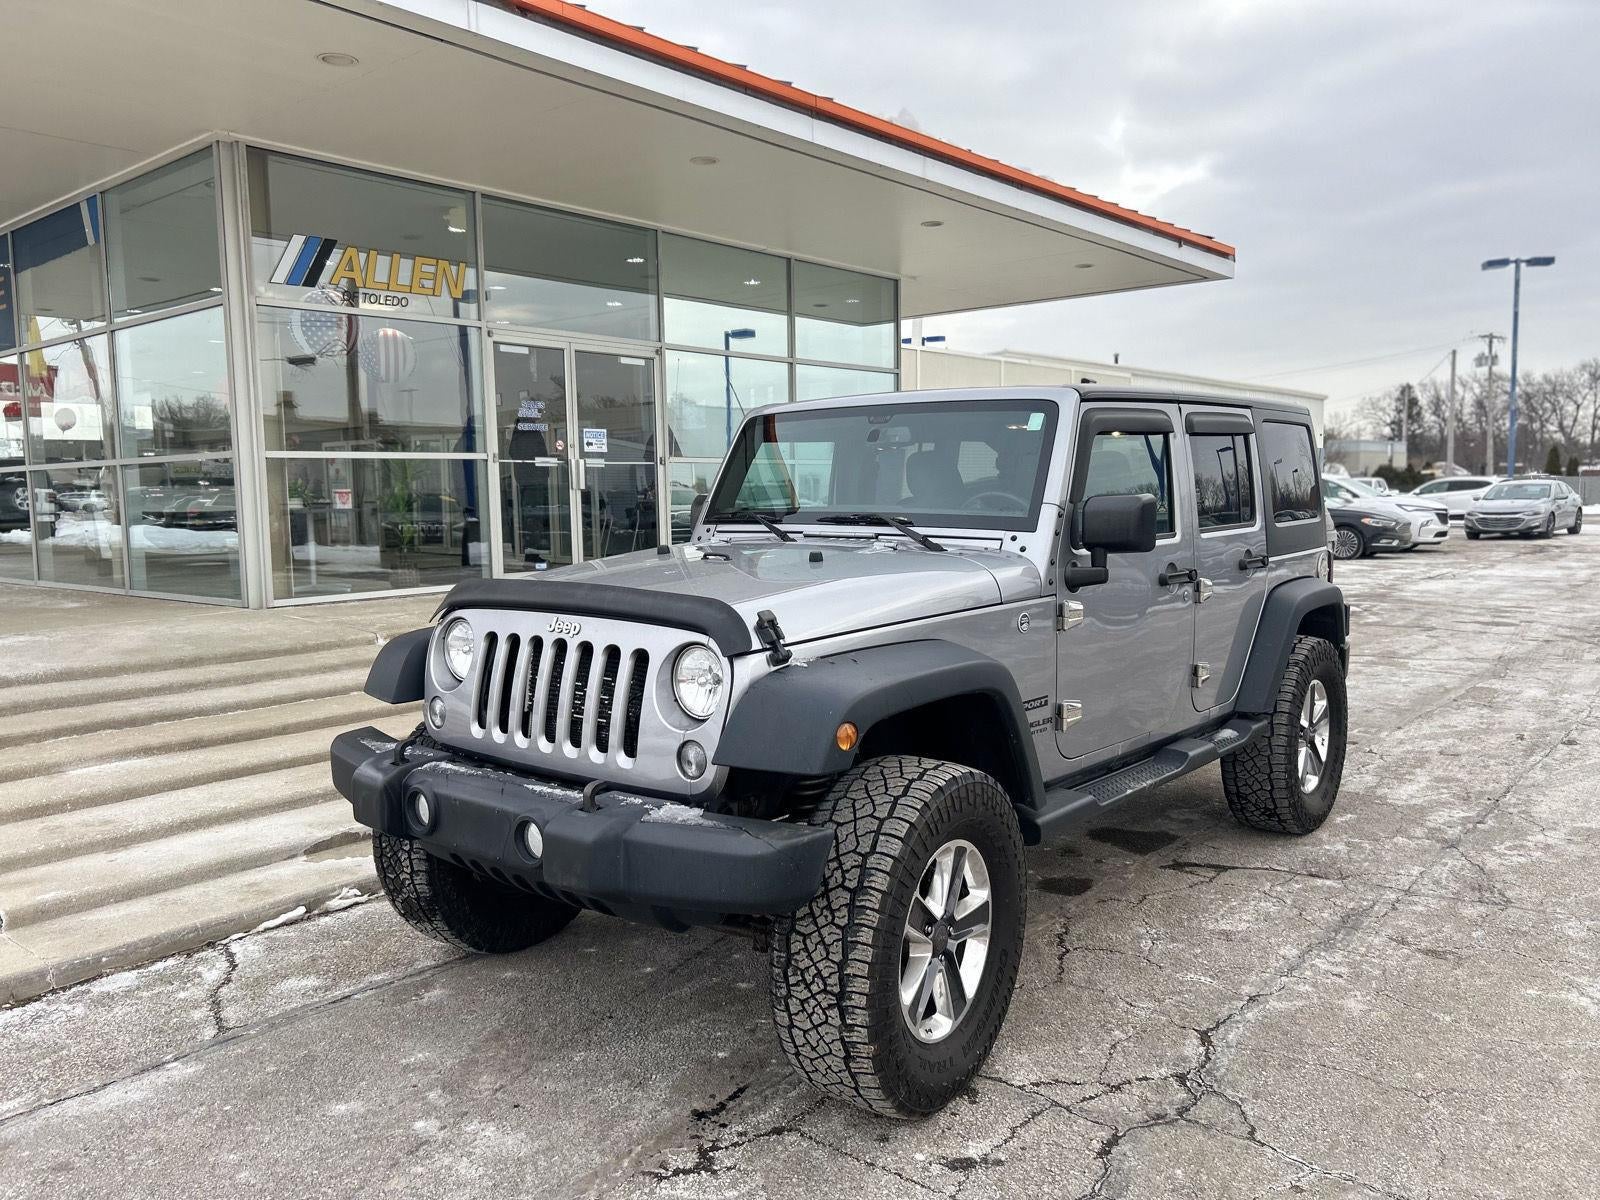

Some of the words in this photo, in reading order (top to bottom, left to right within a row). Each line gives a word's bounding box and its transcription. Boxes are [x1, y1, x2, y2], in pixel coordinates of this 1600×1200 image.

[331, 245, 466, 298] ALLEN
[362, 292, 409, 307] TOLEDO
[517, 422, 549, 431] SERVICE
[585, 431, 605, 439] NOTICE
[547, 616, 581, 638] Jeep
[1023, 697, 1048, 709] PORT
[1029, 716, 1053, 728] GLER
